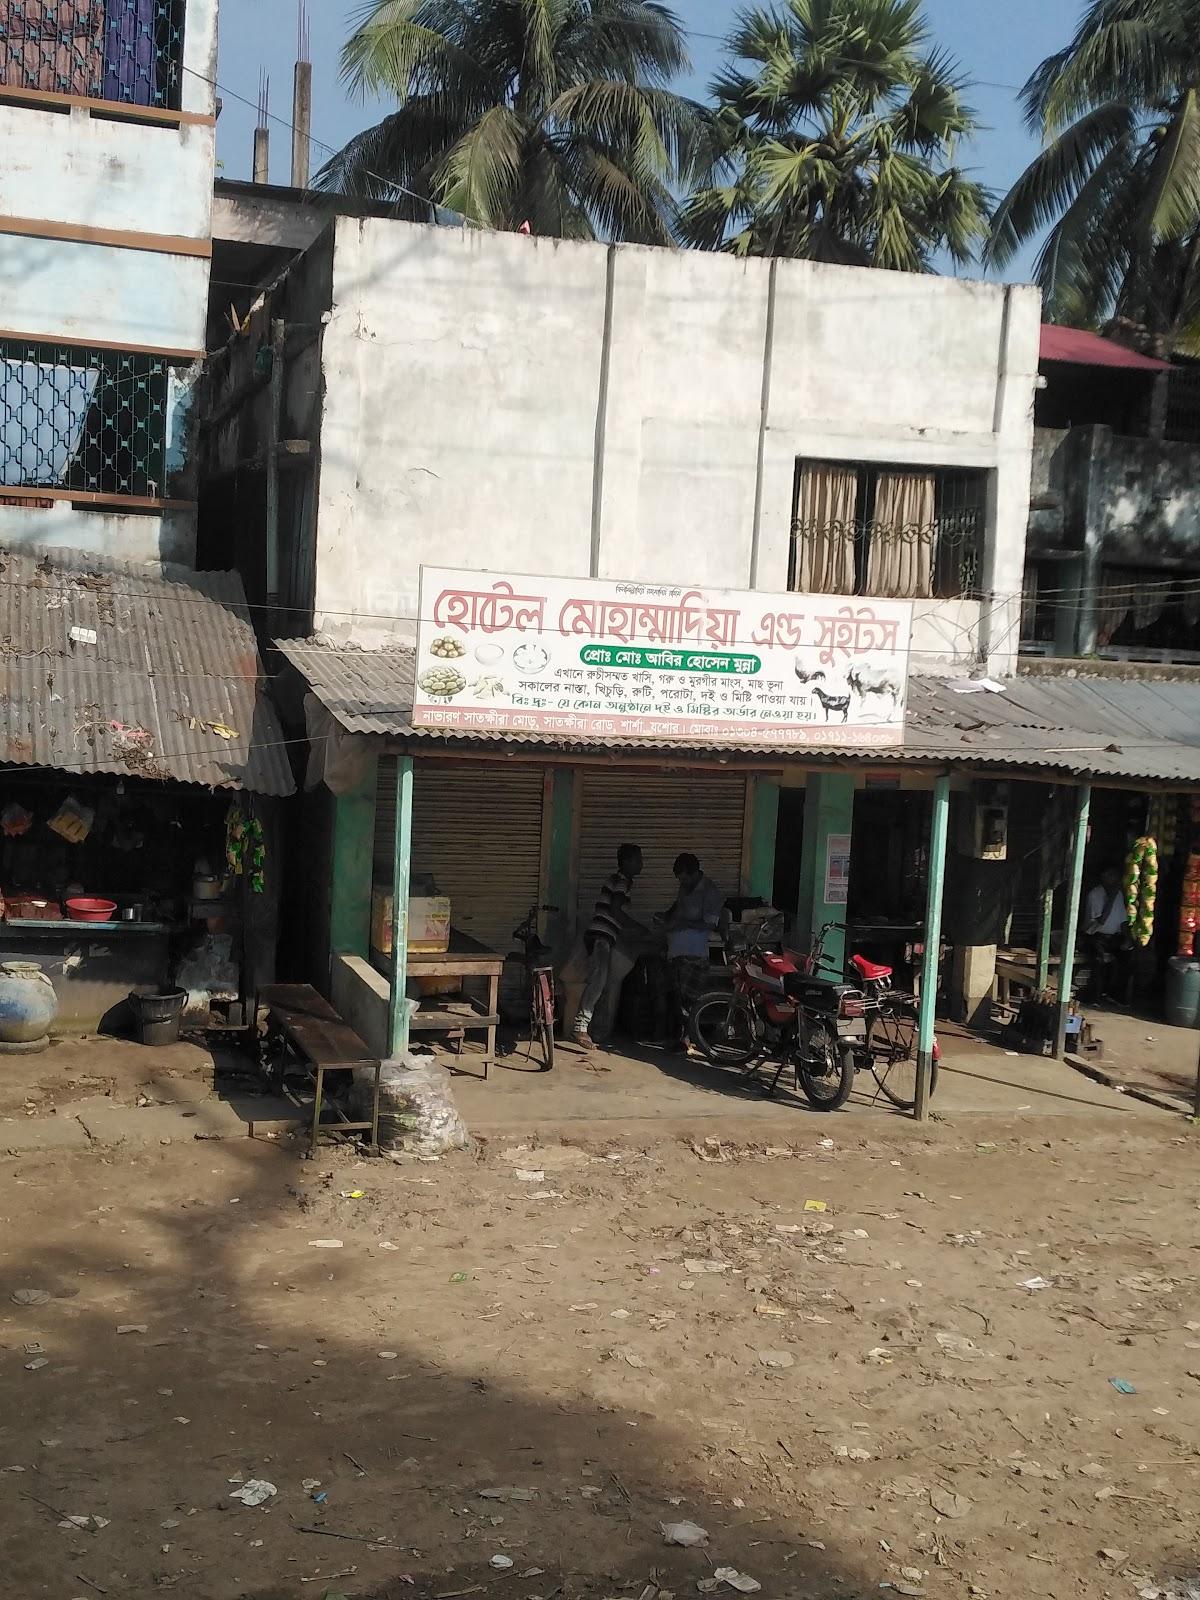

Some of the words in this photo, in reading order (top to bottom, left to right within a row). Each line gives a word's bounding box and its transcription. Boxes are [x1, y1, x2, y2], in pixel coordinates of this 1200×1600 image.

[434, 581, 547, 635] হোটেল
[559, 591, 741, 650] মোহাম্মাদিয়া
[814, 606, 900, 668] সুইটস
[584, 649, 611, 664] প্রোঃ
[616, 652, 641, 666] মোঃ
[645, 651, 684, 668] আবির
[687, 656, 730, 671] হোসেন
[554, 668, 584, 680] এখানে
[632, 670, 655, 684] খাসি,
[659, 674, 675, 684] গরু
[679, 676, 686, 684] ও
[689, 675, 717, 688] মুরগীর
[720, 678, 744, 690] মাংস,
[748, 680, 764, 690] মাছ
[519, 680, 560, 693] সকালের
[701, 690, 715, 702] দই
[720, 692, 728, 701] ও
[756, 693, 786, 705] পাওয়া
[558, 698, 570, 709] যে
[574, 699, 601, 710] কোন
[655, 702, 671, 714] দই
[674, 704, 684, 714] ও
